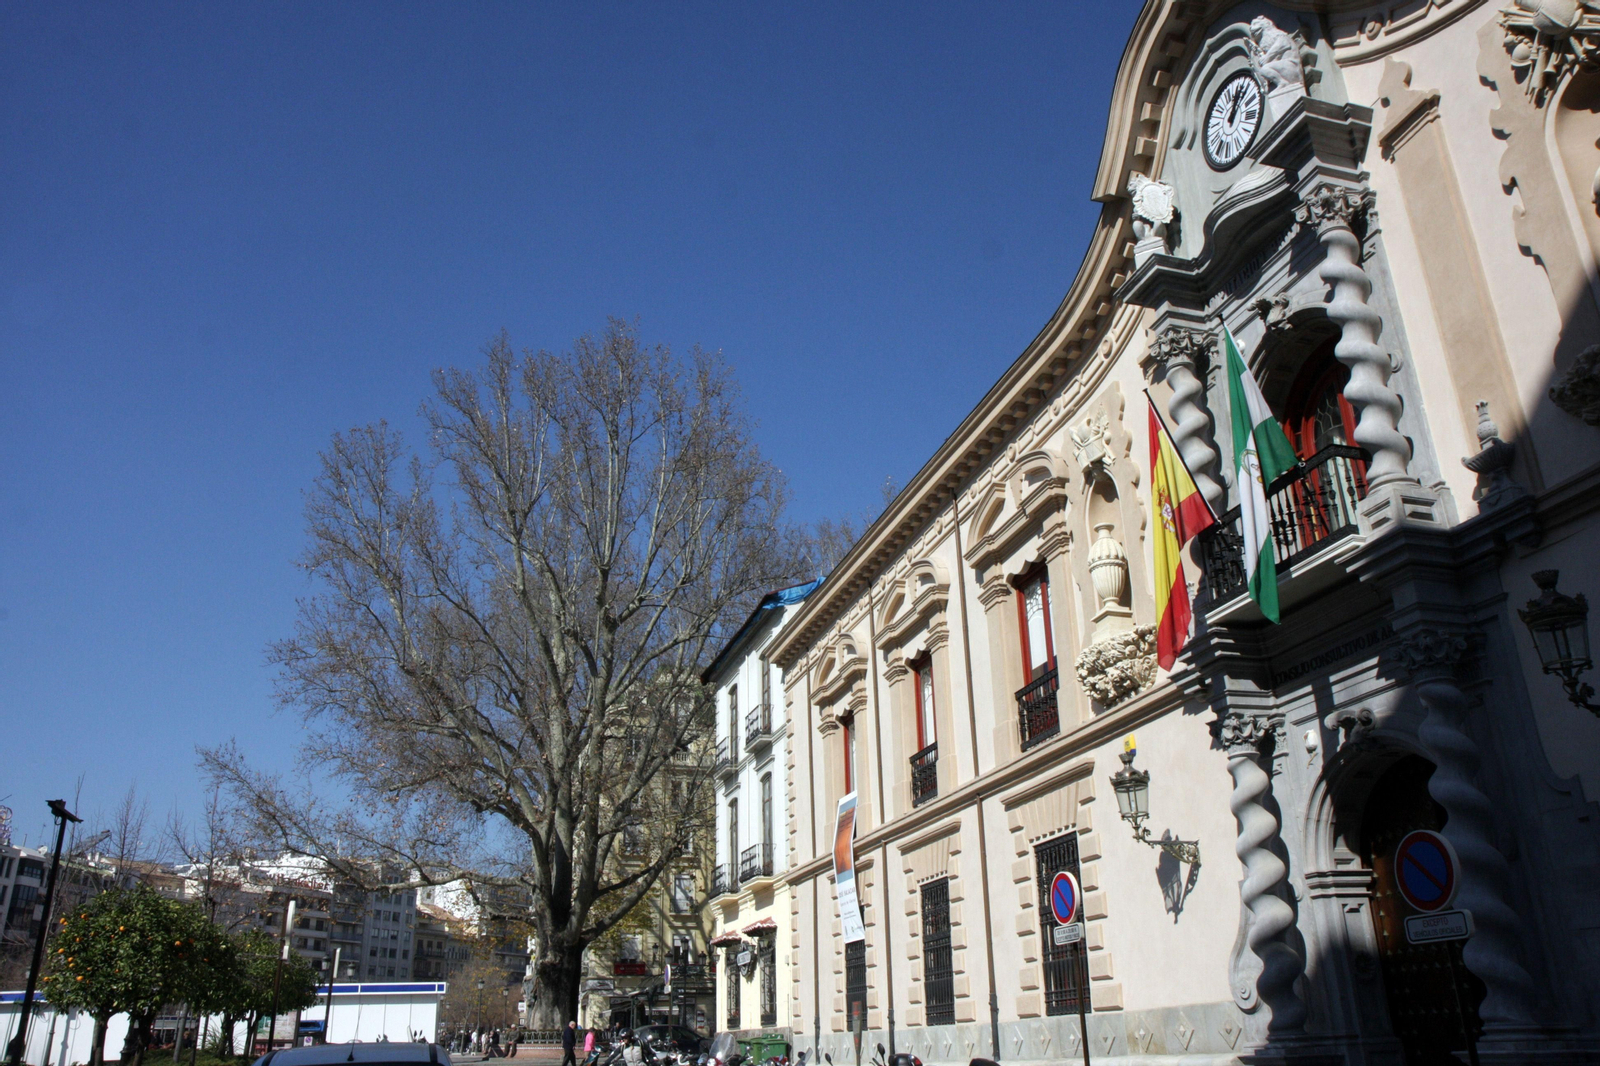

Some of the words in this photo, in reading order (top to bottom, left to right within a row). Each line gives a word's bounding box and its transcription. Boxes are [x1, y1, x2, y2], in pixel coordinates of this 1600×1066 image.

[1310, 636, 1366, 671] CONSULTIVO
[1366, 630, 1380, 648] DE
[1422, 917, 1449, 928] EXCEPTO
[1439, 926, 1463, 936] OFICIALES
